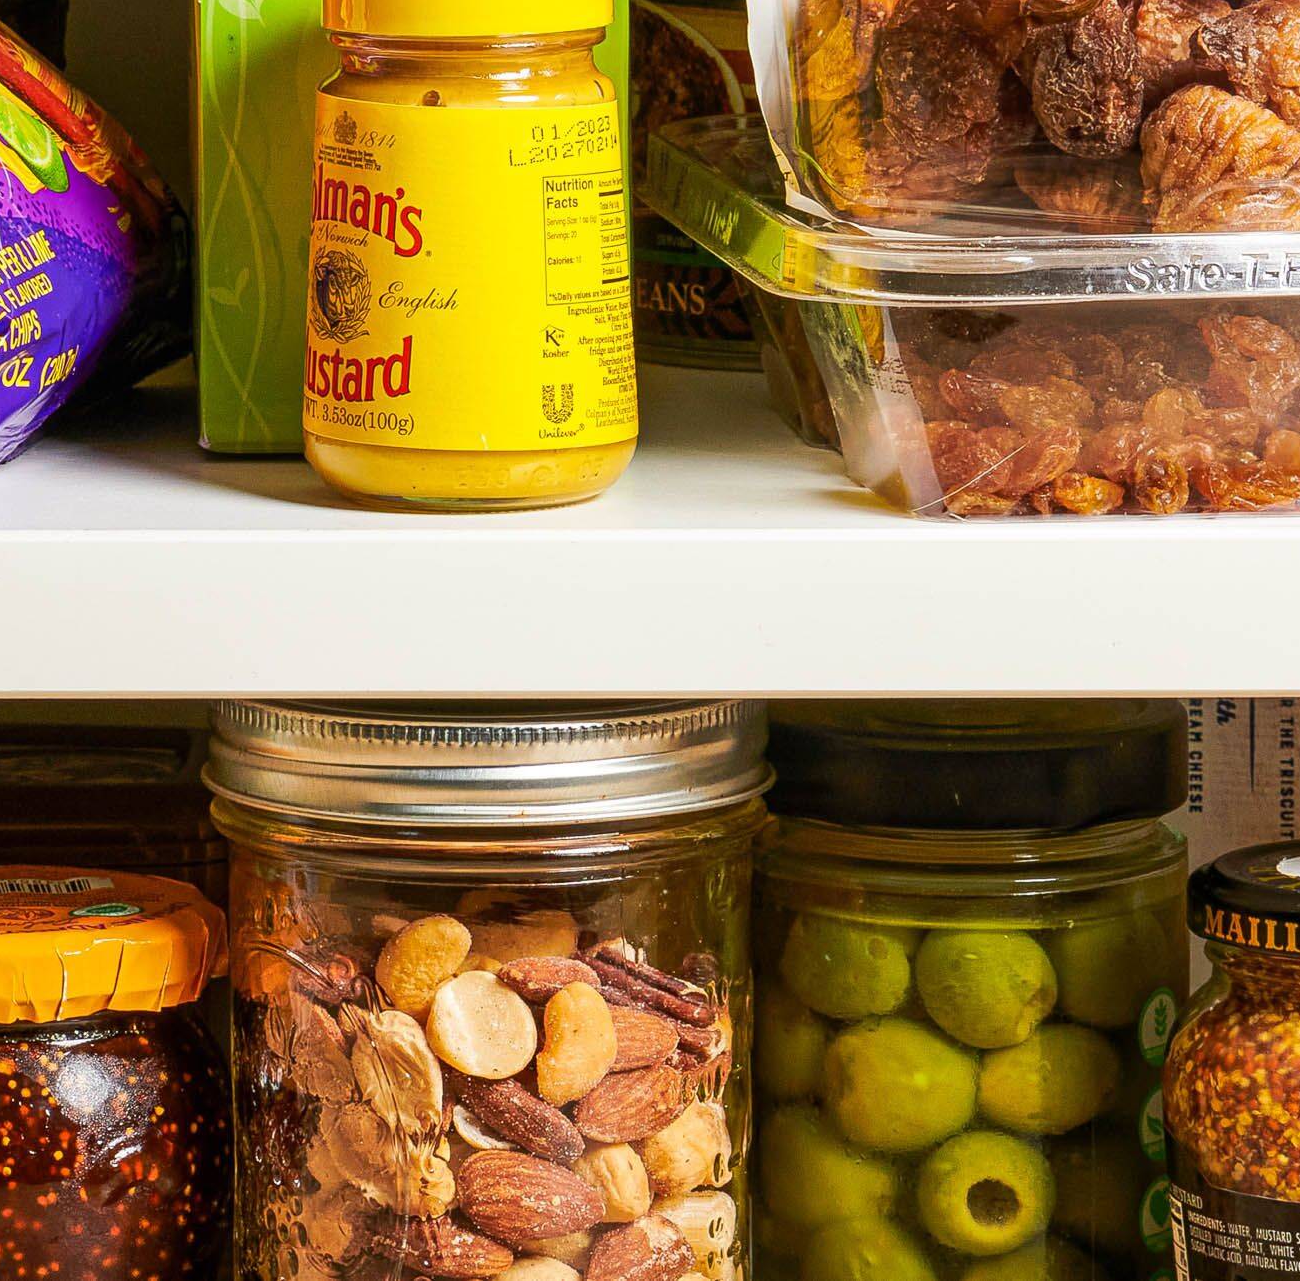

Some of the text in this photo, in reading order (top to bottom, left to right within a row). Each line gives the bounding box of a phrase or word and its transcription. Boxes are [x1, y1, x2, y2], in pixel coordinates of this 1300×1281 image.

[545, 178, 594, 194] Nutrition
[546, 197, 579, 210] Facts
[4, 272, 54, 310] FLAVORED
[378, 281, 459, 318] English
[10, 308, 42, 350] CHIPS
[542, 348, 570, 359] Kosher
[1280, 757, 1294, 840] TRISCUIT
[1256, 1228, 1292, 1244] MUSTARD
